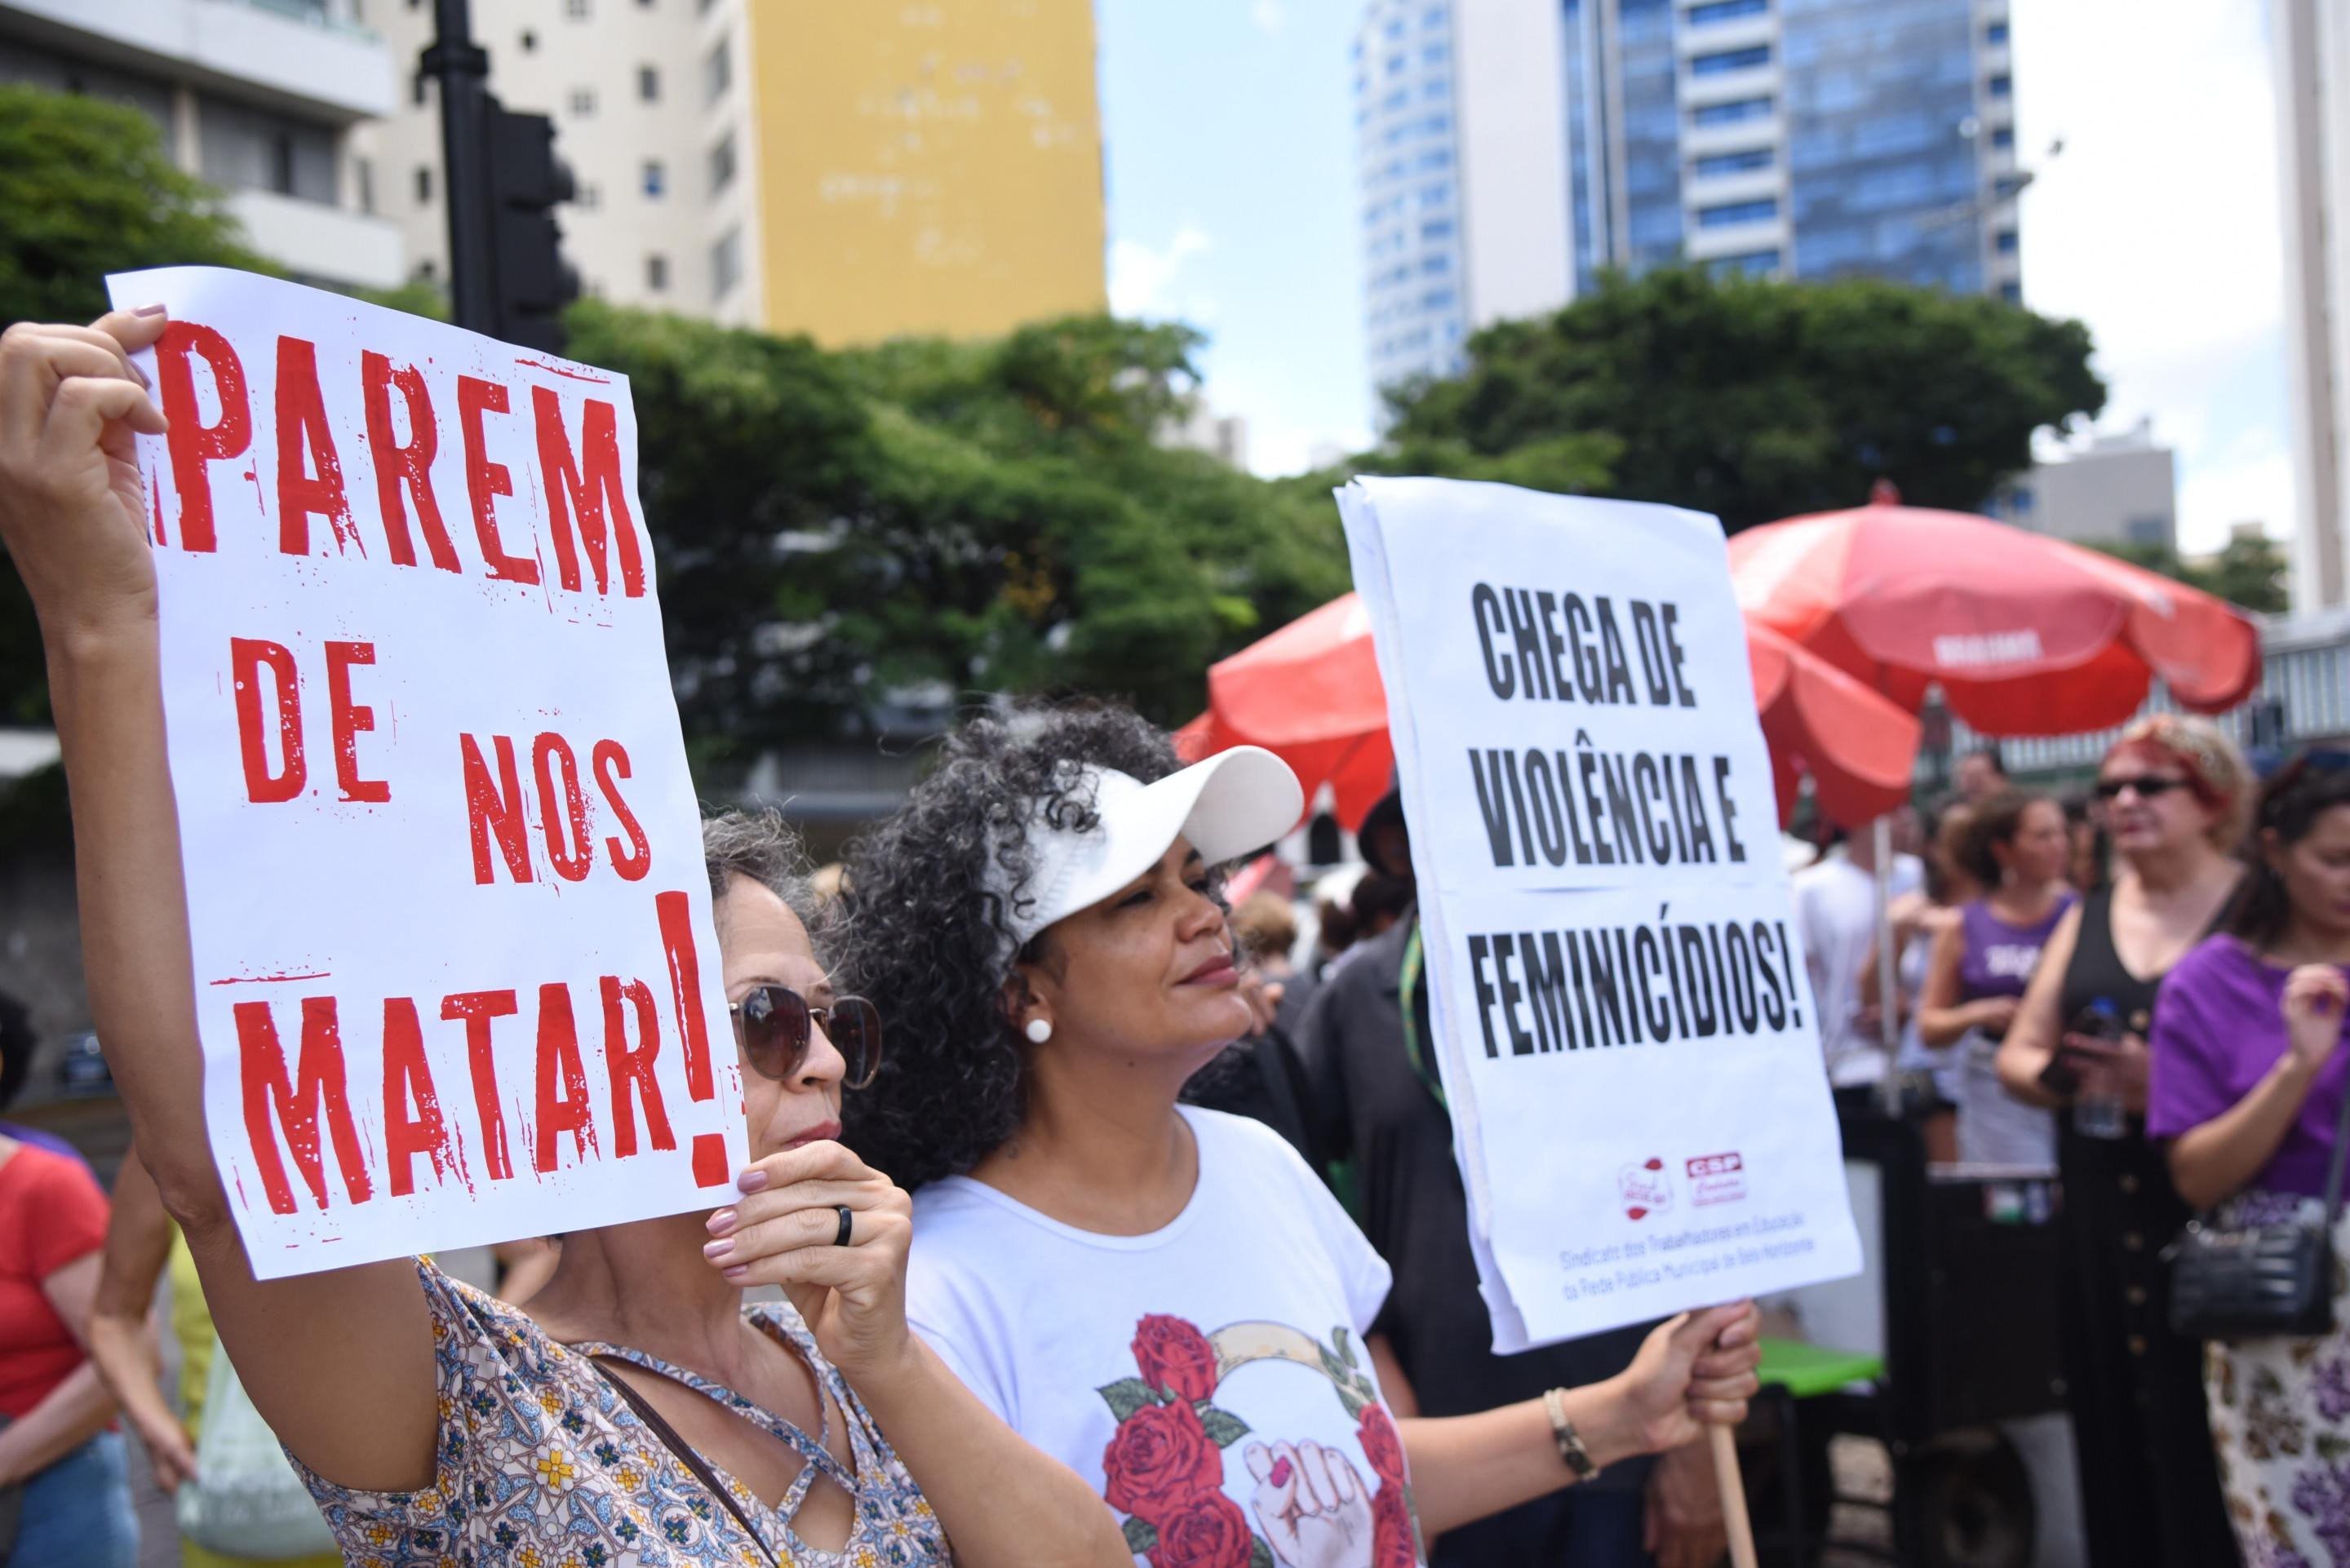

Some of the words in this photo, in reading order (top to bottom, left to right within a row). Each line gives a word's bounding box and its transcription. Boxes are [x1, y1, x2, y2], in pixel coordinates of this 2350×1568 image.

[153, 320, 645, 598] PAREM
[230, 636, 392, 804] DE
[1472, 582, 1636, 705] CHEGA
[1629, 598, 1696, 708] DE
[460, 732, 652, 885] NOS
[1468, 728, 1716, 866] VIOLÊNCIA
[1714, 755, 1746, 864] E
[233, 890, 729, 1215] MATAR!
[1467, 902, 1802, 1060] FEMINICÍDIOS!
